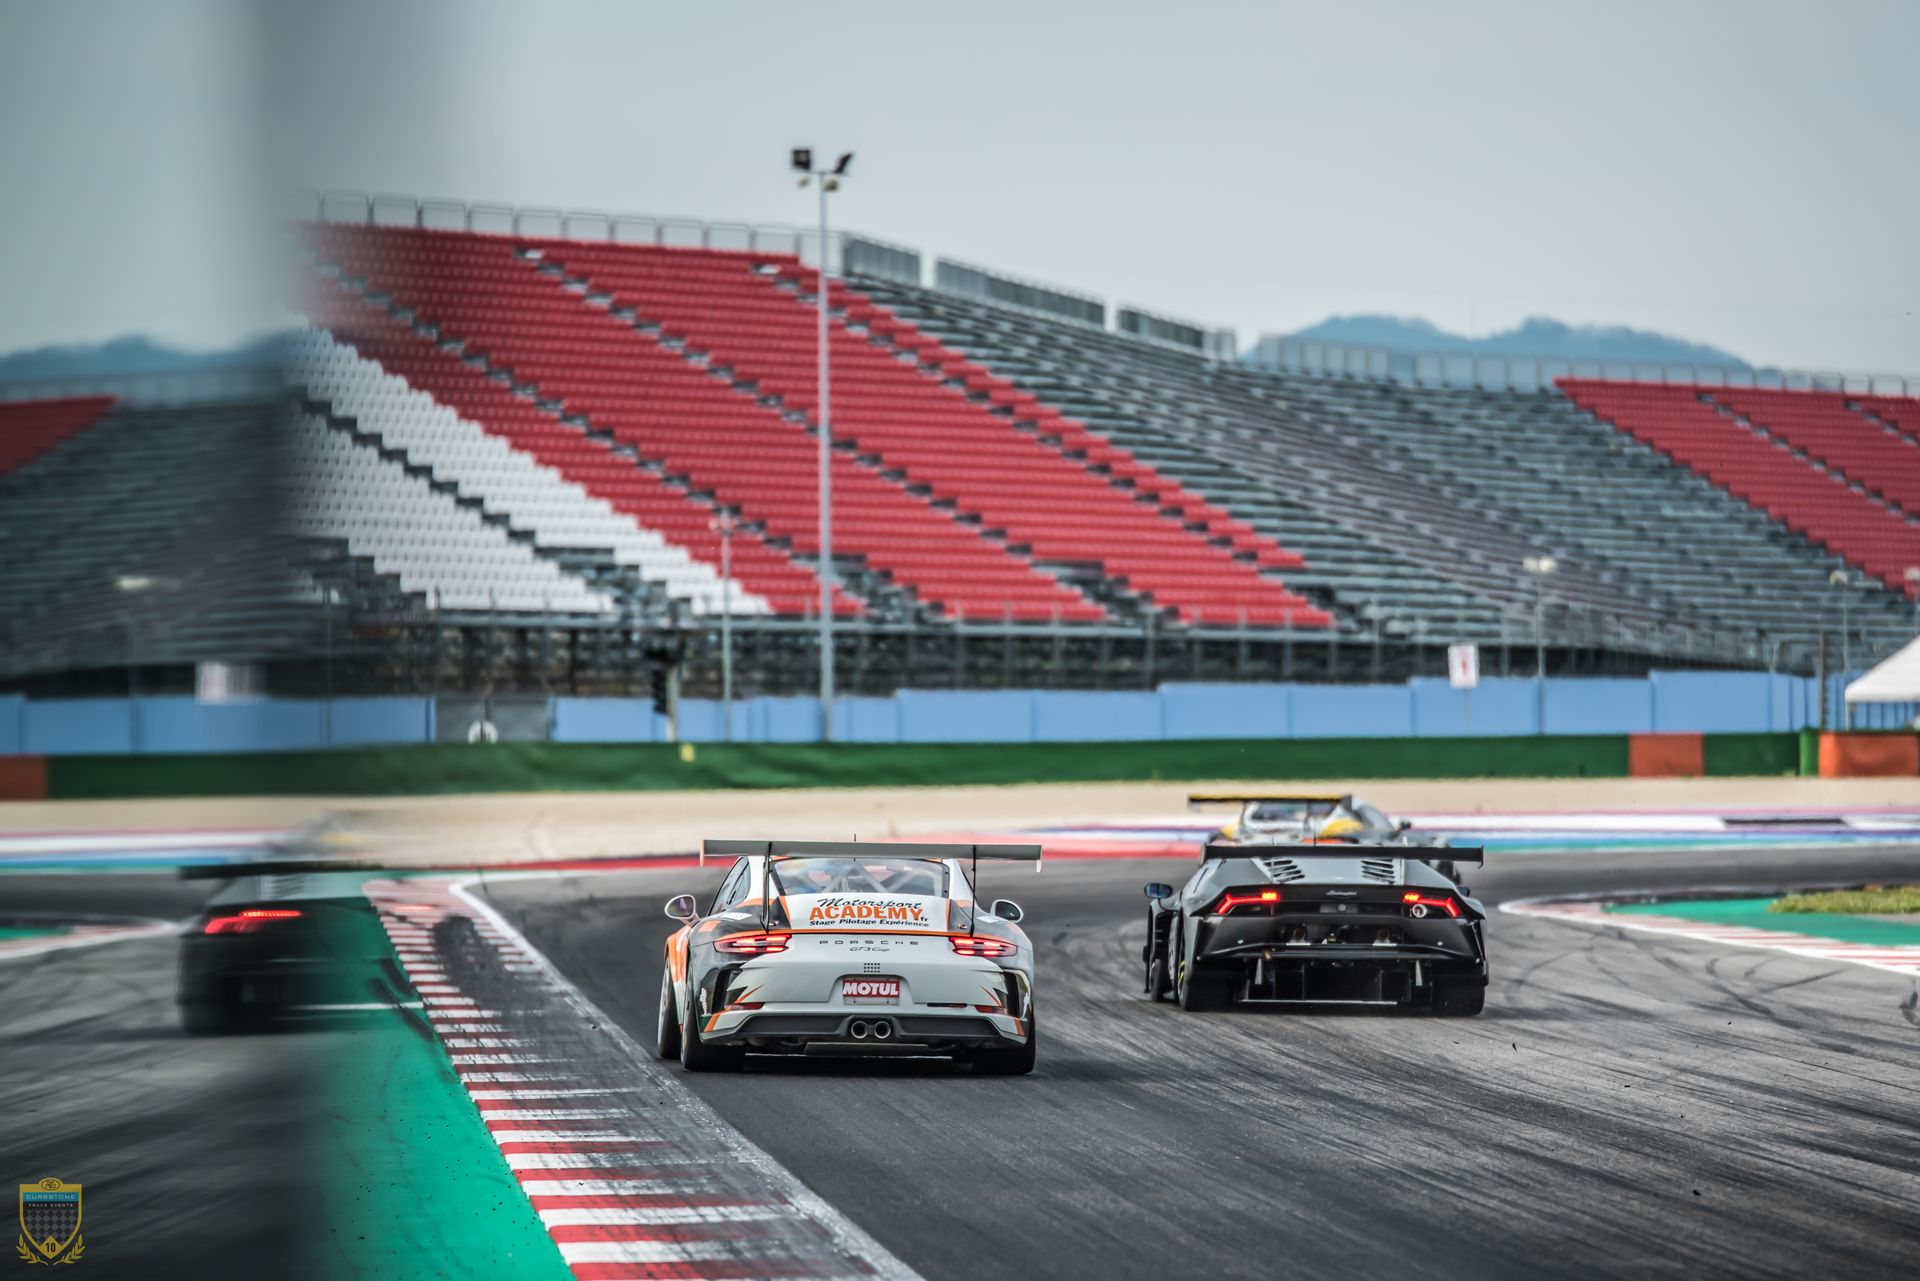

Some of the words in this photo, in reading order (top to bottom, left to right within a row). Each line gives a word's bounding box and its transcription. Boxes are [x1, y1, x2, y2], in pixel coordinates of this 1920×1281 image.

[816, 898, 922, 909] Motorsport
[809, 906, 923, 921] ACADEMY
[839, 918, 877, 926] Pilotage
[842, 982, 899, 995] MOTUL
